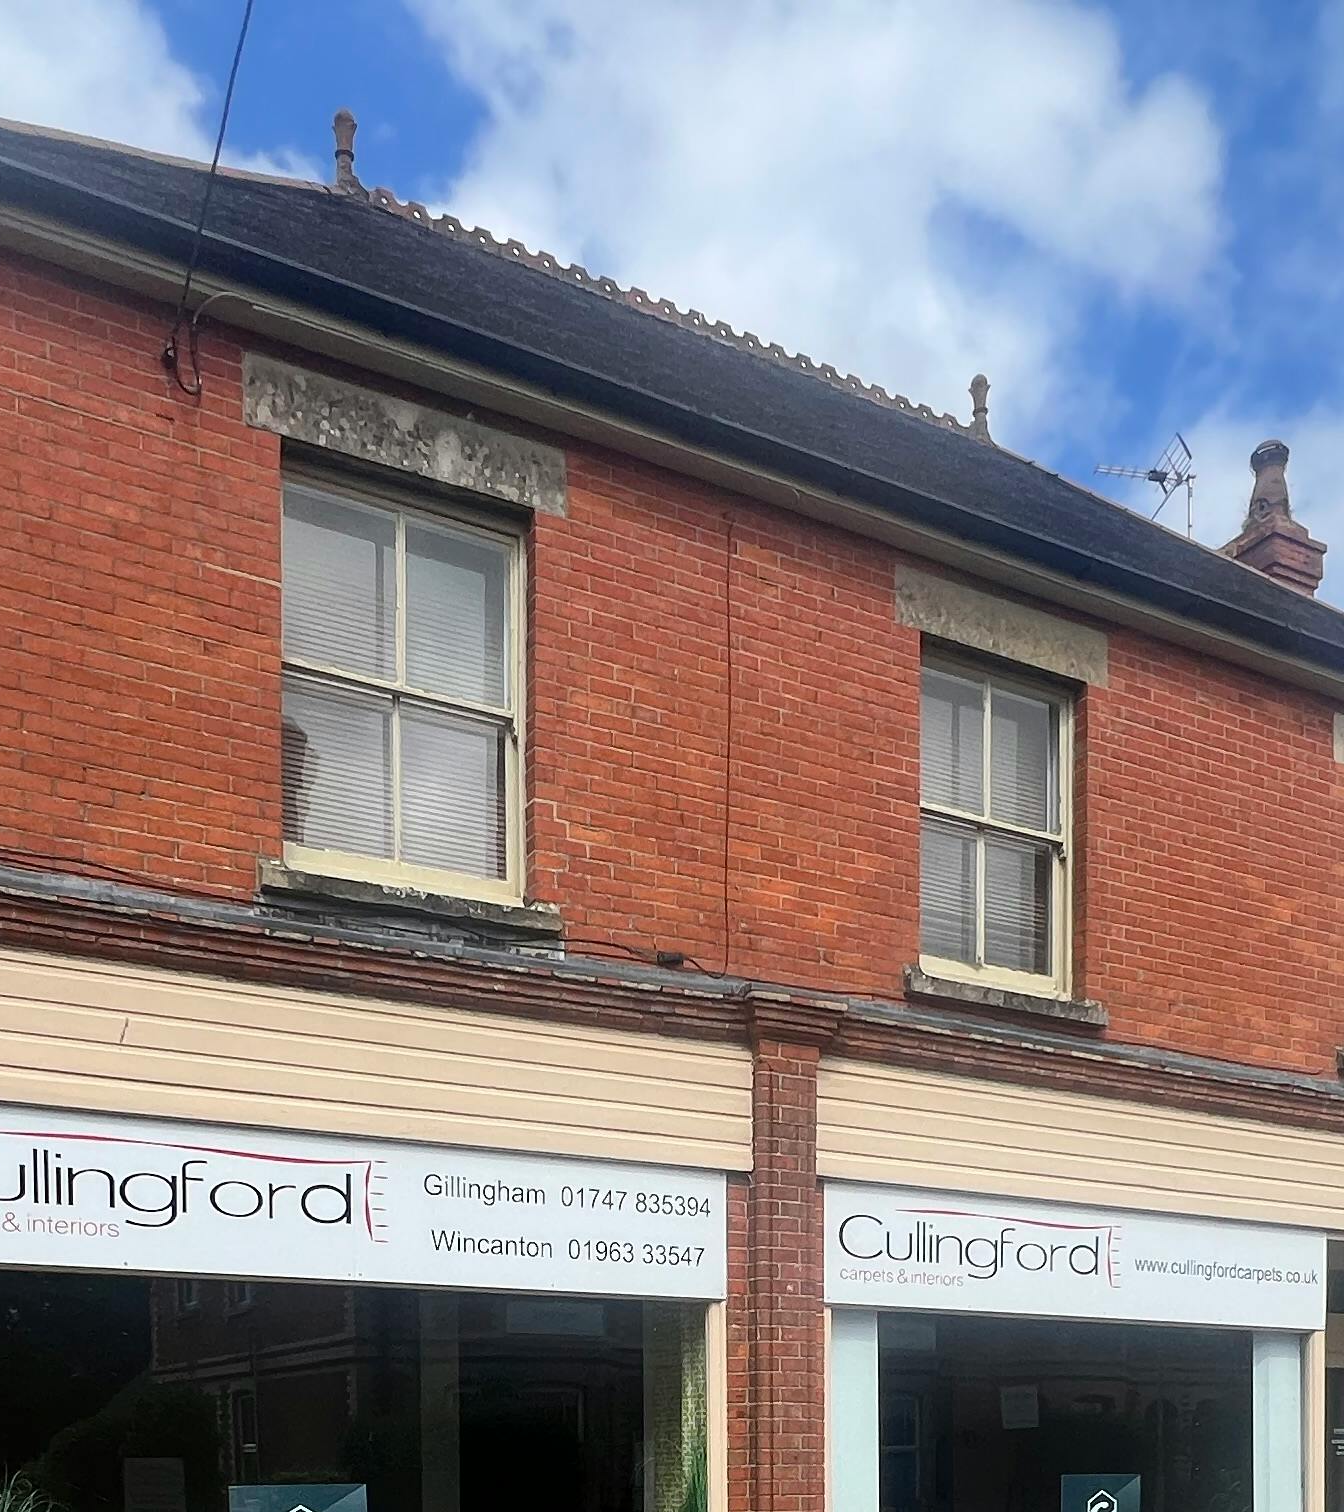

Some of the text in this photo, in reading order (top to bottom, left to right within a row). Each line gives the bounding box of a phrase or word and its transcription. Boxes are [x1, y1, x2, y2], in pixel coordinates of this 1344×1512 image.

[423, 1173, 711, 1218] Gillingham 01747 835394
[1, 1211, 22, 1233] &
[25, 1213, 121, 1239] interiors
[431, 1229, 706, 1267] Wincanton 01963 33547
[838, 1213, 1100, 1281] Cullingford
[839, 1265, 964, 1289] carpets & interiors
[1134, 1255, 1320, 1286] www.cullingfordcarpets.co.uk
